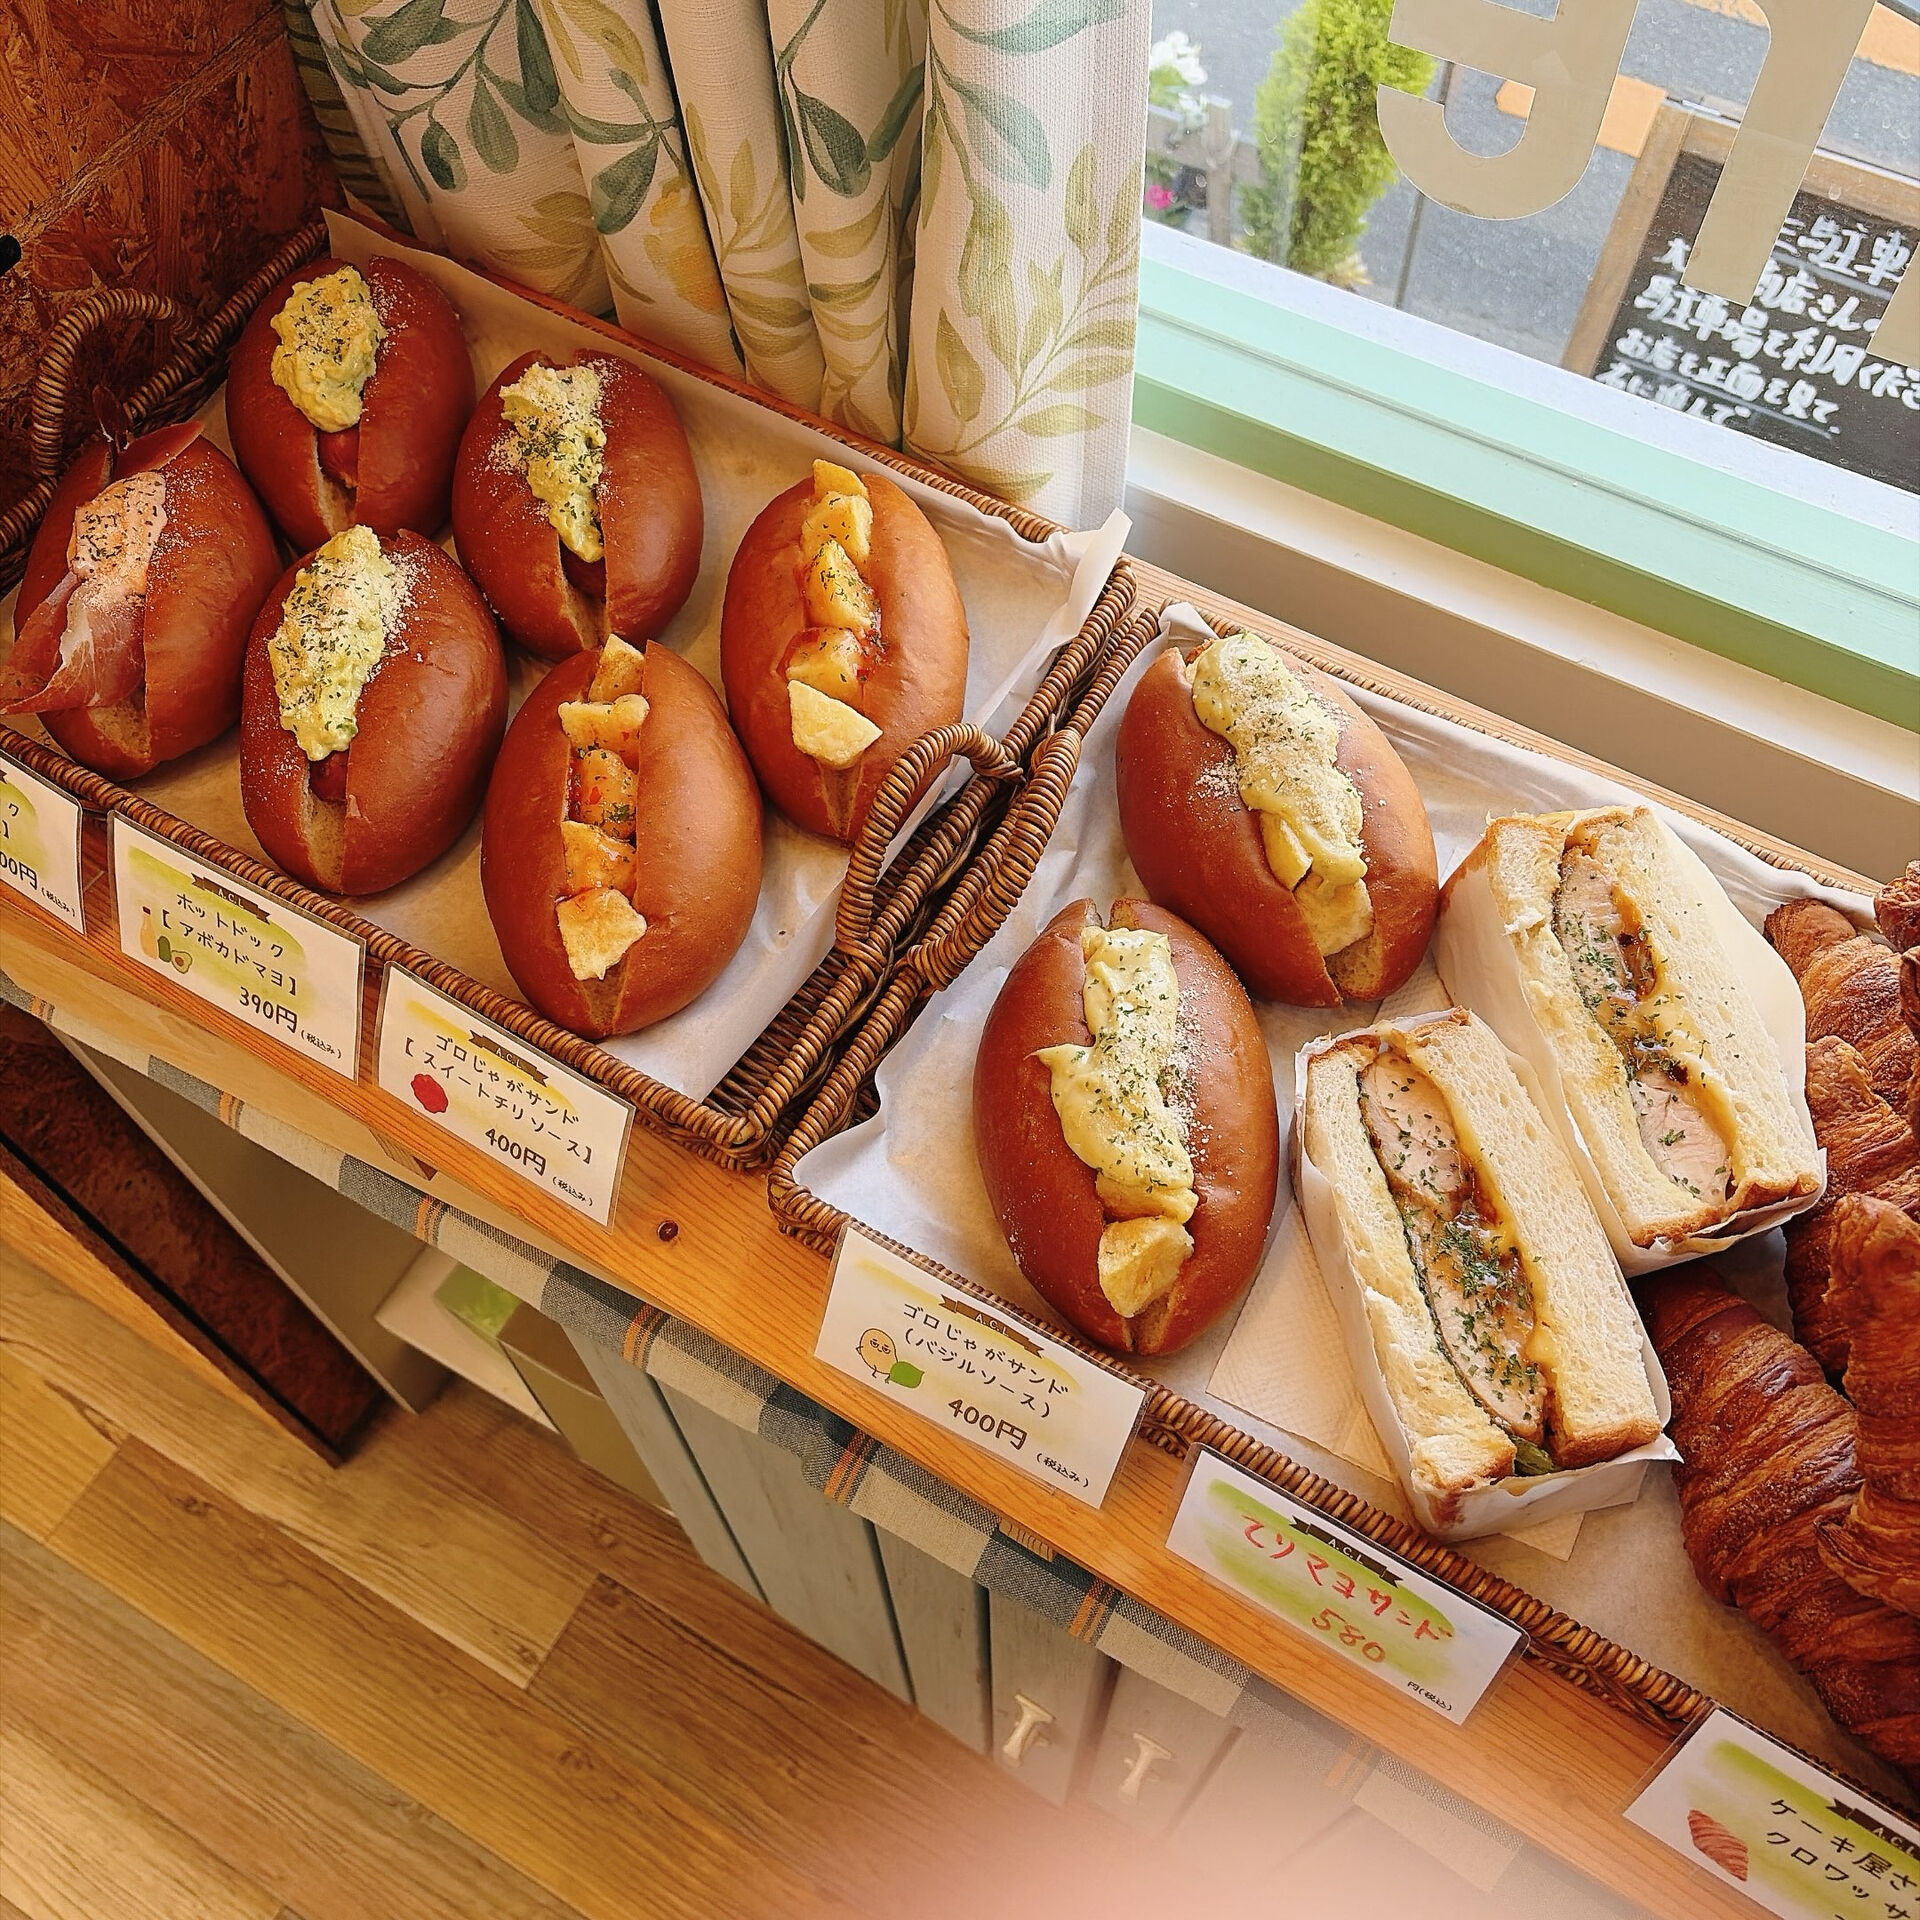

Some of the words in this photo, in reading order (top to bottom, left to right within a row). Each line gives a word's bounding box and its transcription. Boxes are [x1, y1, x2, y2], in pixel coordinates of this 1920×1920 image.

[160, 908, 298, 996] 【アボカドマヨ】
[176, 892, 285, 959] ホットドック
[239, 986, 298, 1034] 390円
[404, 1036, 593, 1165] 【スイートチリソース】
[435, 1034, 580, 1126] ゴロじゃがサンド
[484, 1127, 547, 1177] 400円
[903, 1302, 1069, 1396] ゴロじゃがサンド
[904, 1327, 1051, 1419] （バジルソース）
[948, 1398, 1028, 1451] 400円
[1311, 1608, 1387, 1664] 580
[1770, 1798, 1920, 1902] ケーキ屋さ
